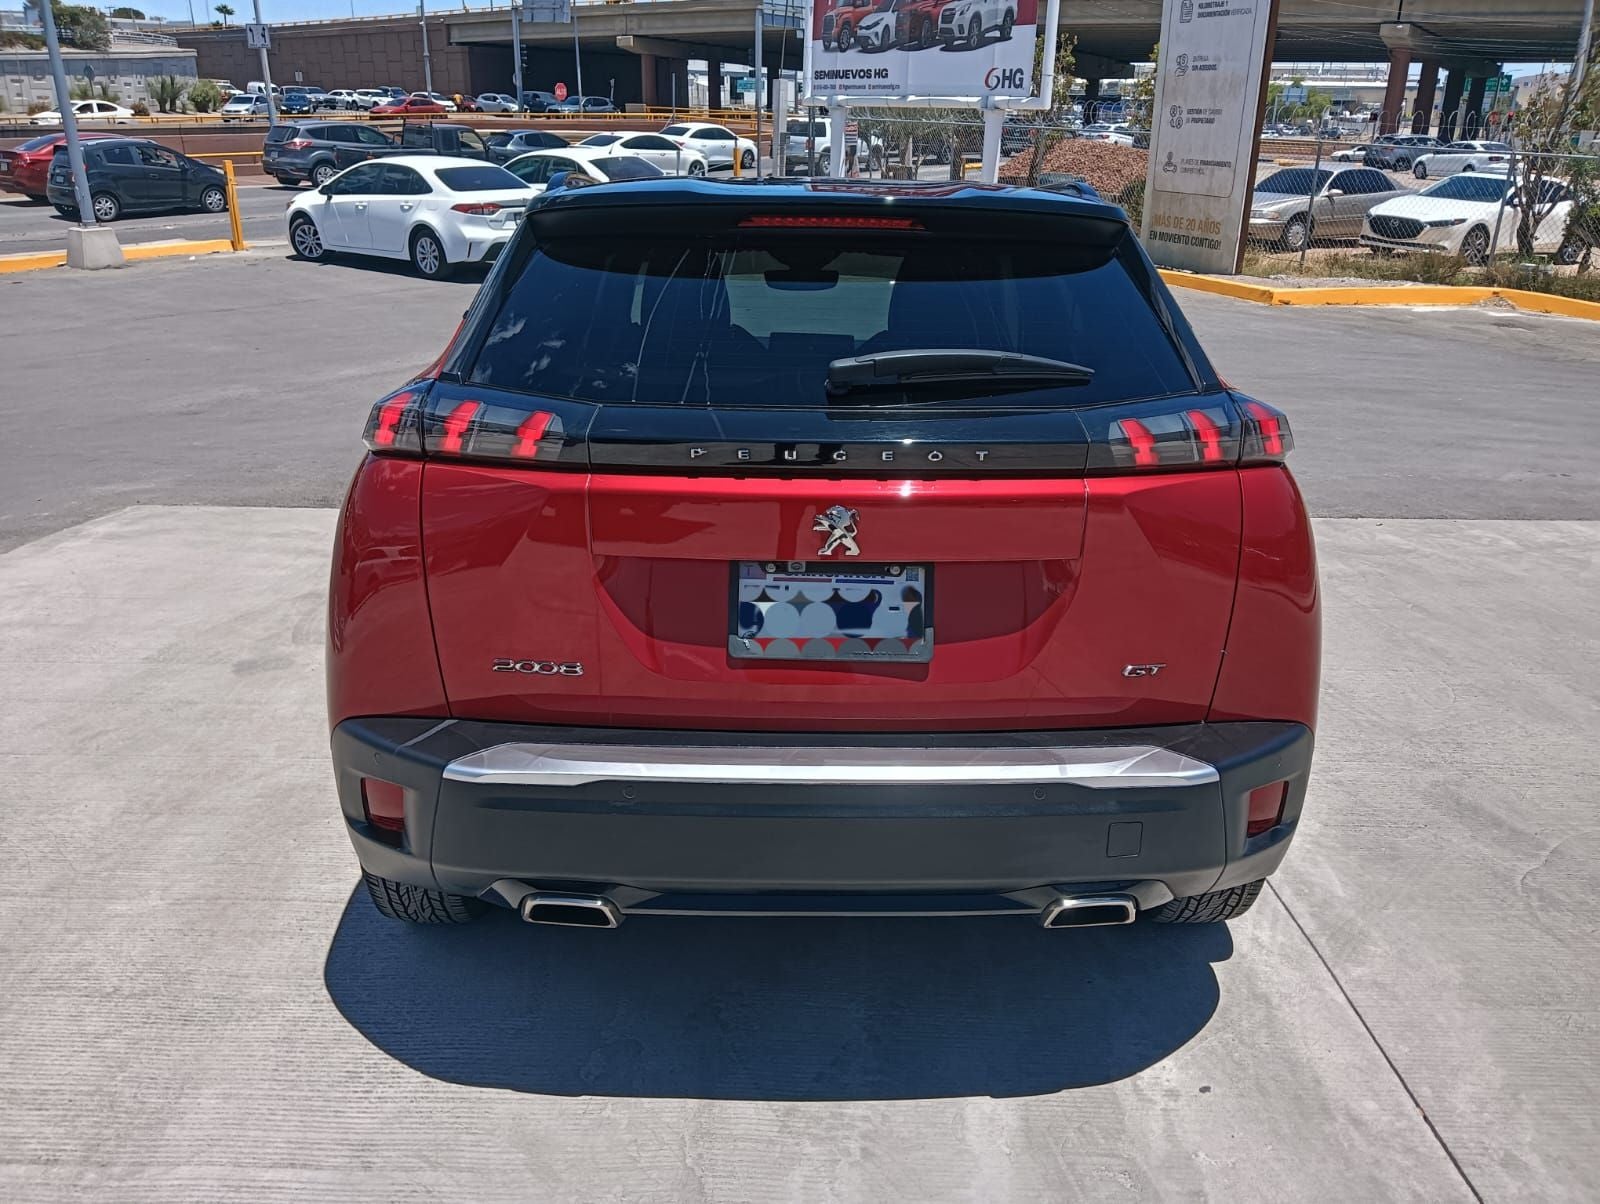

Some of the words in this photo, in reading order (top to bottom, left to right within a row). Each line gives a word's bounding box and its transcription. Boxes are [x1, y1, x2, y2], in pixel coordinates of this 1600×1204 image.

[814, 68, 873, 80] SEMINUEVOS
[873, 68, 889, 79] HG
[1001, 68, 1025, 89] HG
[1172, 215, 1185, 230] DE
[1185, 218, 1197, 232] 20
[1197, 217, 1222, 235] AÑOS
[1149, 230, 1158, 241] EN
[1190, 236, 1222, 251] CONTIGO!
[690, 448, 989, 463] PEUGEOT
[492, 658, 585, 677] 2008
[1121, 663, 1168, 678] GT
